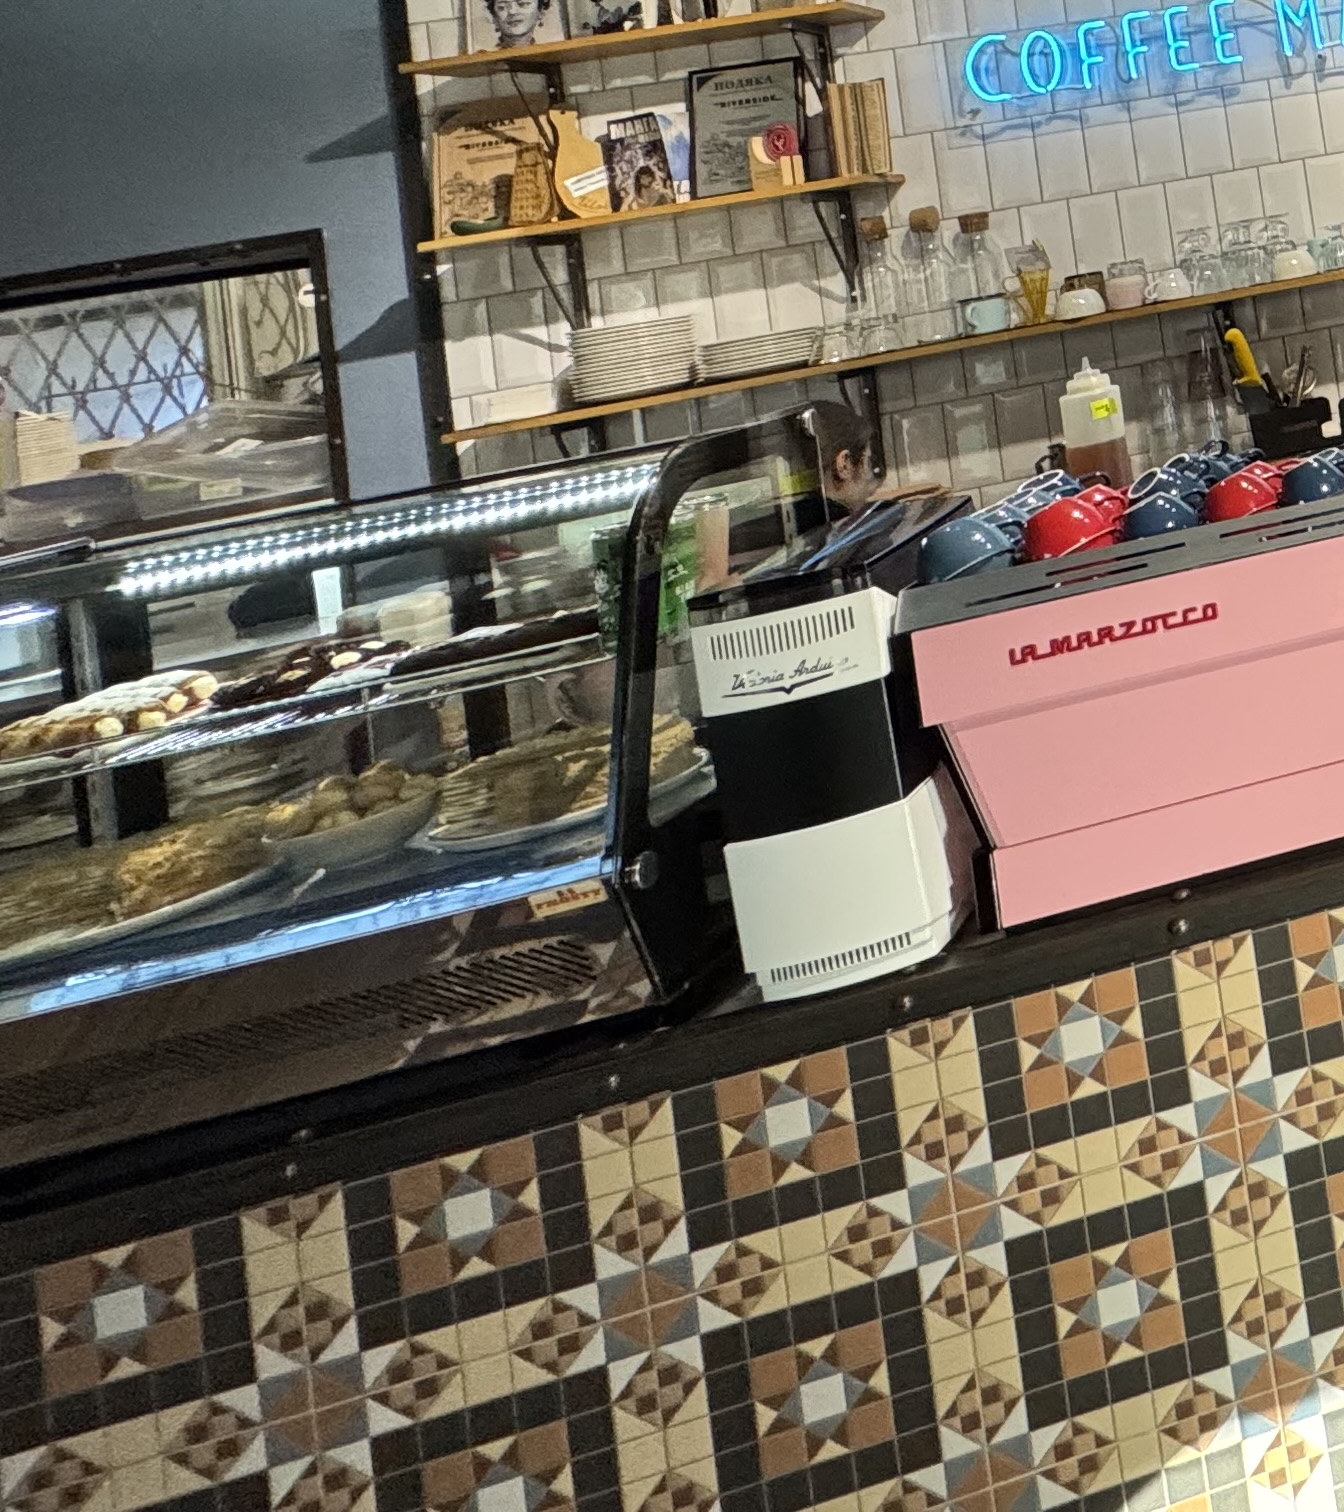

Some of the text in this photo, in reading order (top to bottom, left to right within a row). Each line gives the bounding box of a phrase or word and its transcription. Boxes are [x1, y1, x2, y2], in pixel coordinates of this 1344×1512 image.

[714, 75, 773, 91] ПОДЯКА
[713, 94, 783, 108] RIVERSIDE
[1009, 602, 1219, 666] LA MARZOCCO
